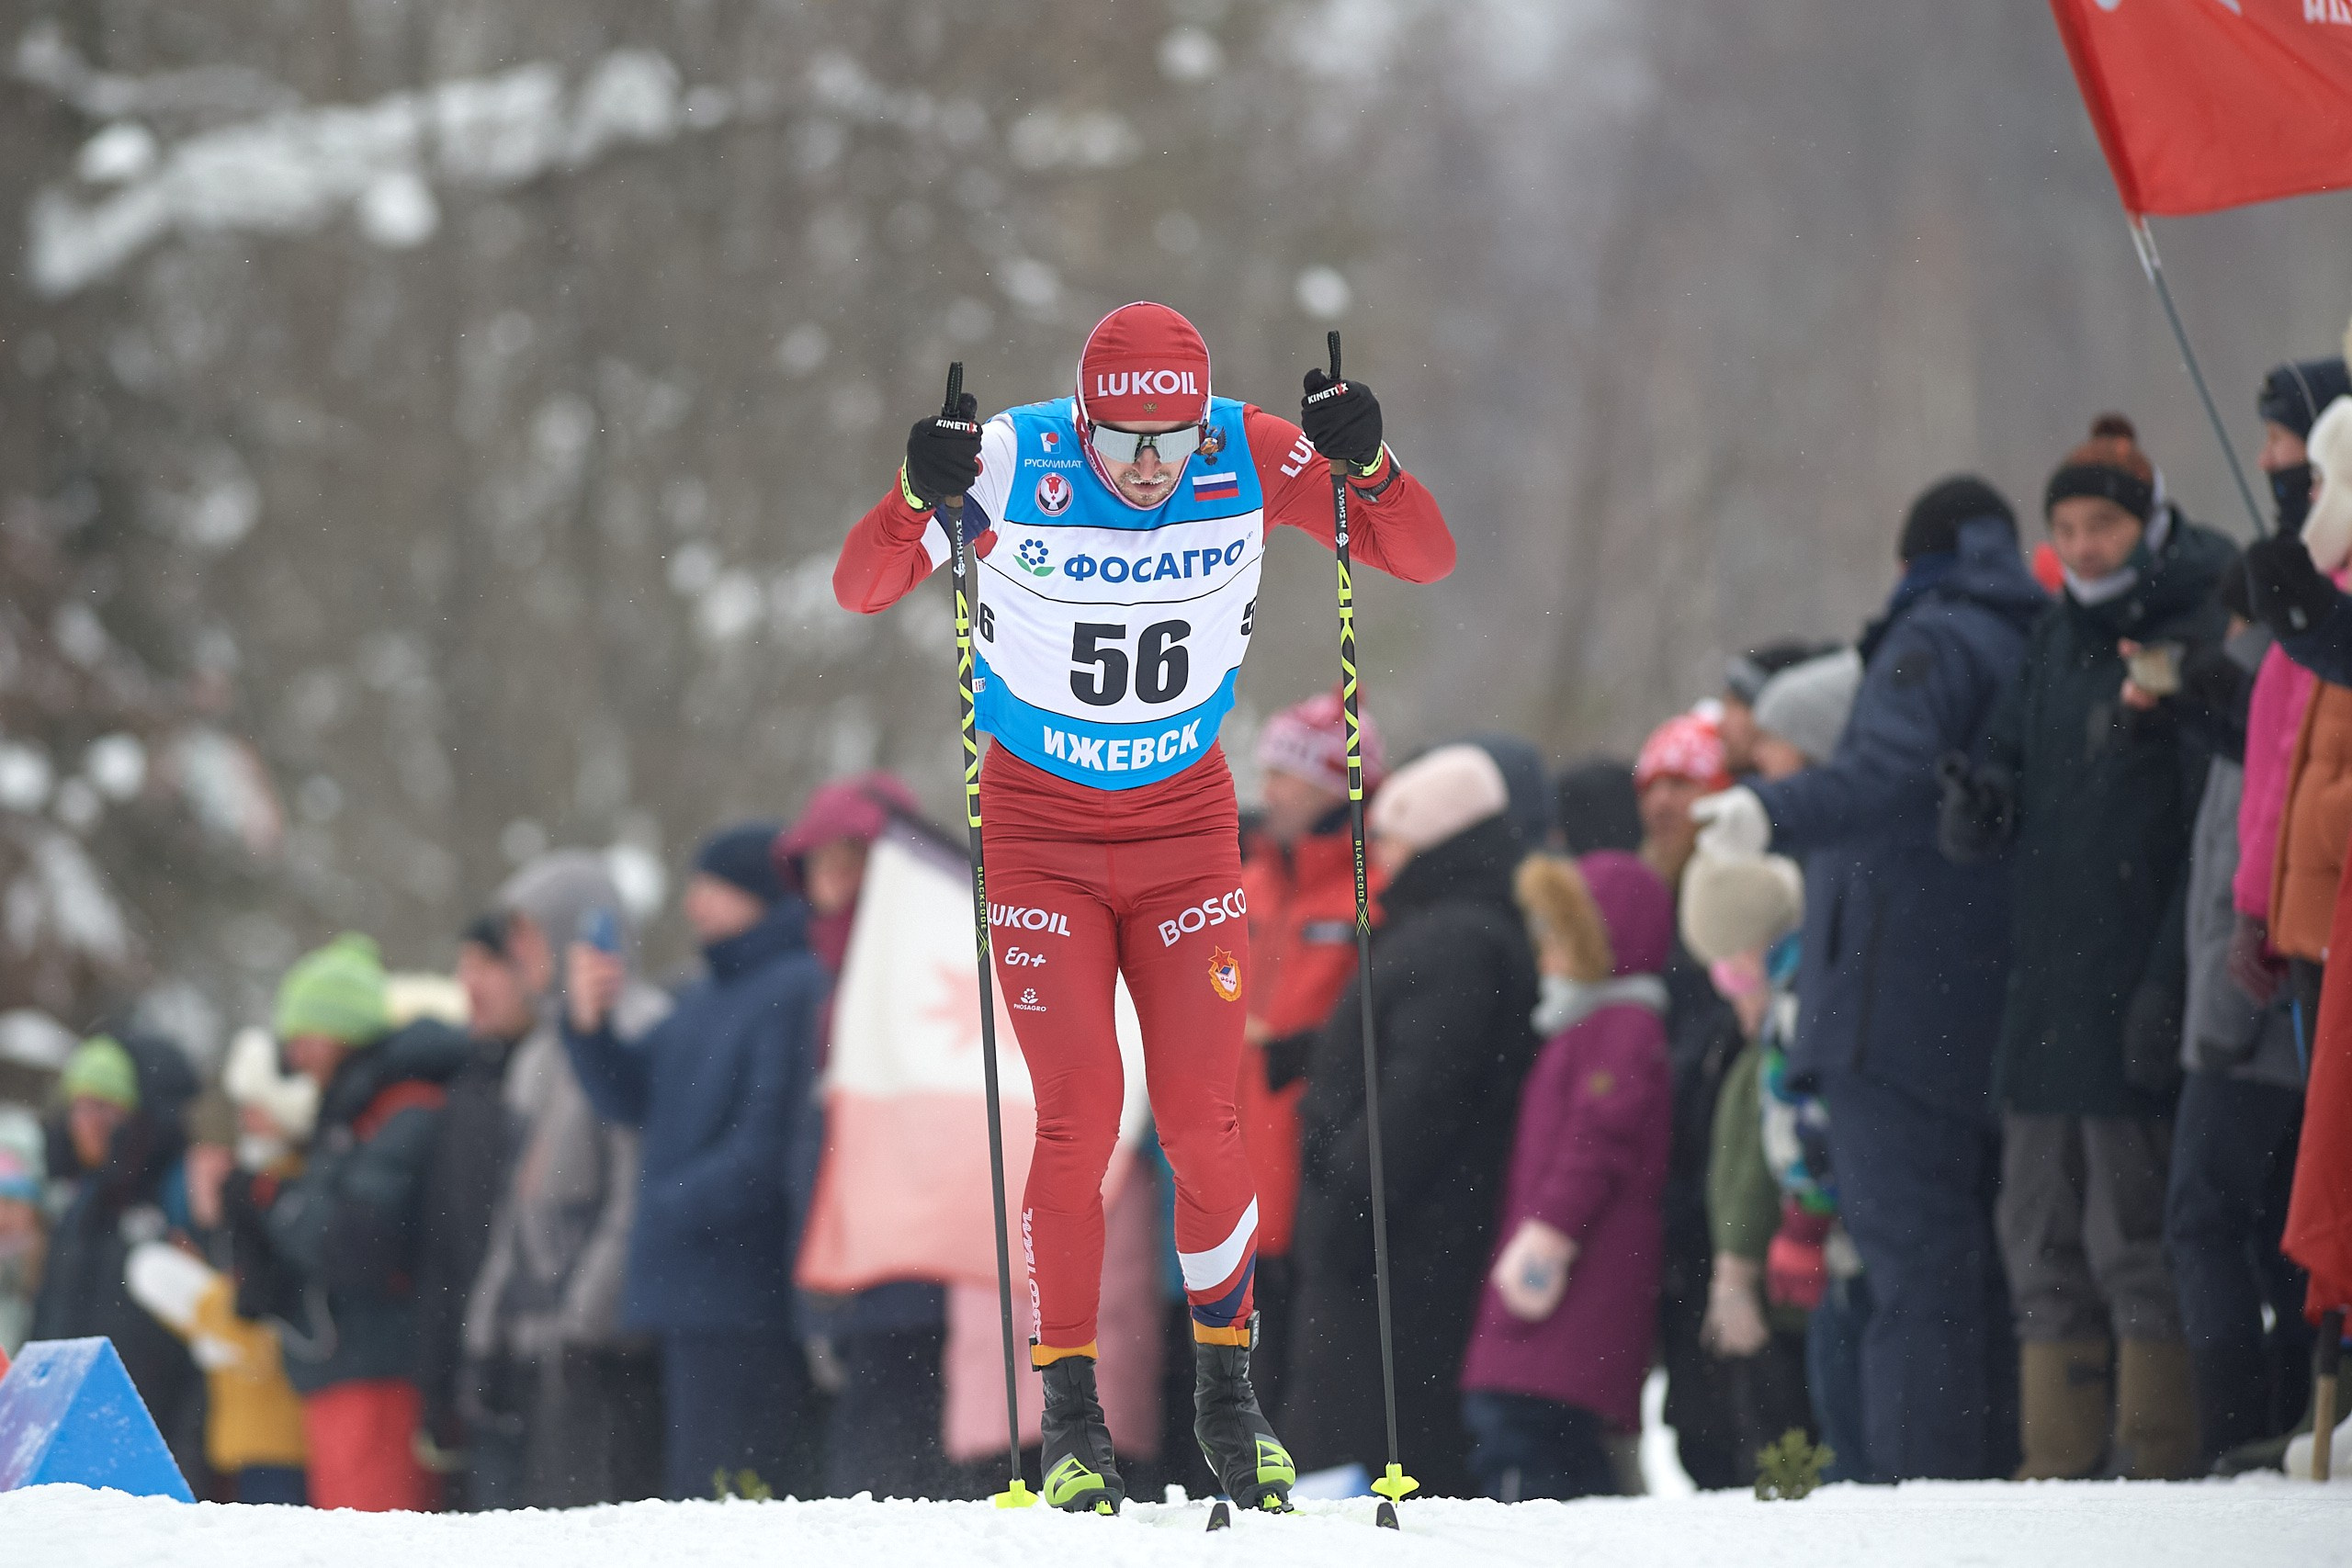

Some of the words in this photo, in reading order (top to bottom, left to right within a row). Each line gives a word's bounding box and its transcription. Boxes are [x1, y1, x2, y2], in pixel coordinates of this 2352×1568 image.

[1097, 369, 1199, 397] LUKOIL
[1023, 458, 1083, 468] РУСКЛИМАТ
[1063, 538, 1245, 583] ФОСАГРО
[1070, 619, 1192, 706] 56
[1044, 717, 1202, 772] ИЖЕВСК
[977, 866, 987, 930] BLACKCODE
[1355, 840, 1365, 904] BLACKCODE
[1158, 887, 1247, 947] BOSCO
[1013, 1002, 1047, 1012] PHOSAGRO
